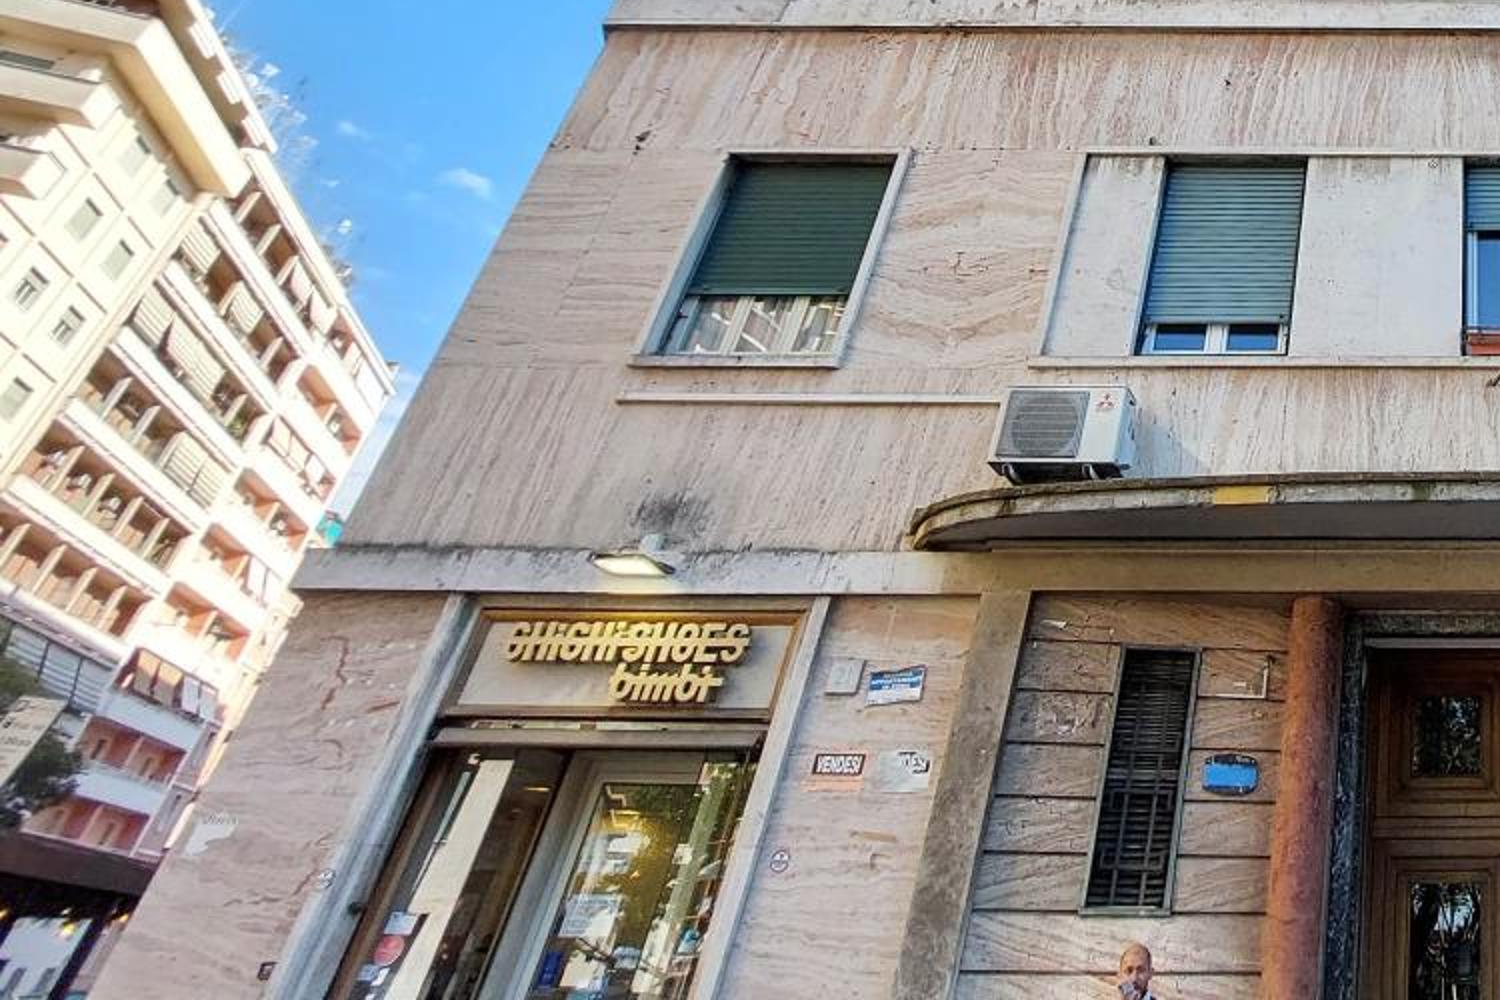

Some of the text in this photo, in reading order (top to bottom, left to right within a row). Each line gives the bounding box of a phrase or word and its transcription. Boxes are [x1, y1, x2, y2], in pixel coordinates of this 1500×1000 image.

[621, 621, 750, 662] SHOES
[608, 663, 723, 702] bimbi
[815, 755, 863, 774] VENDESI
